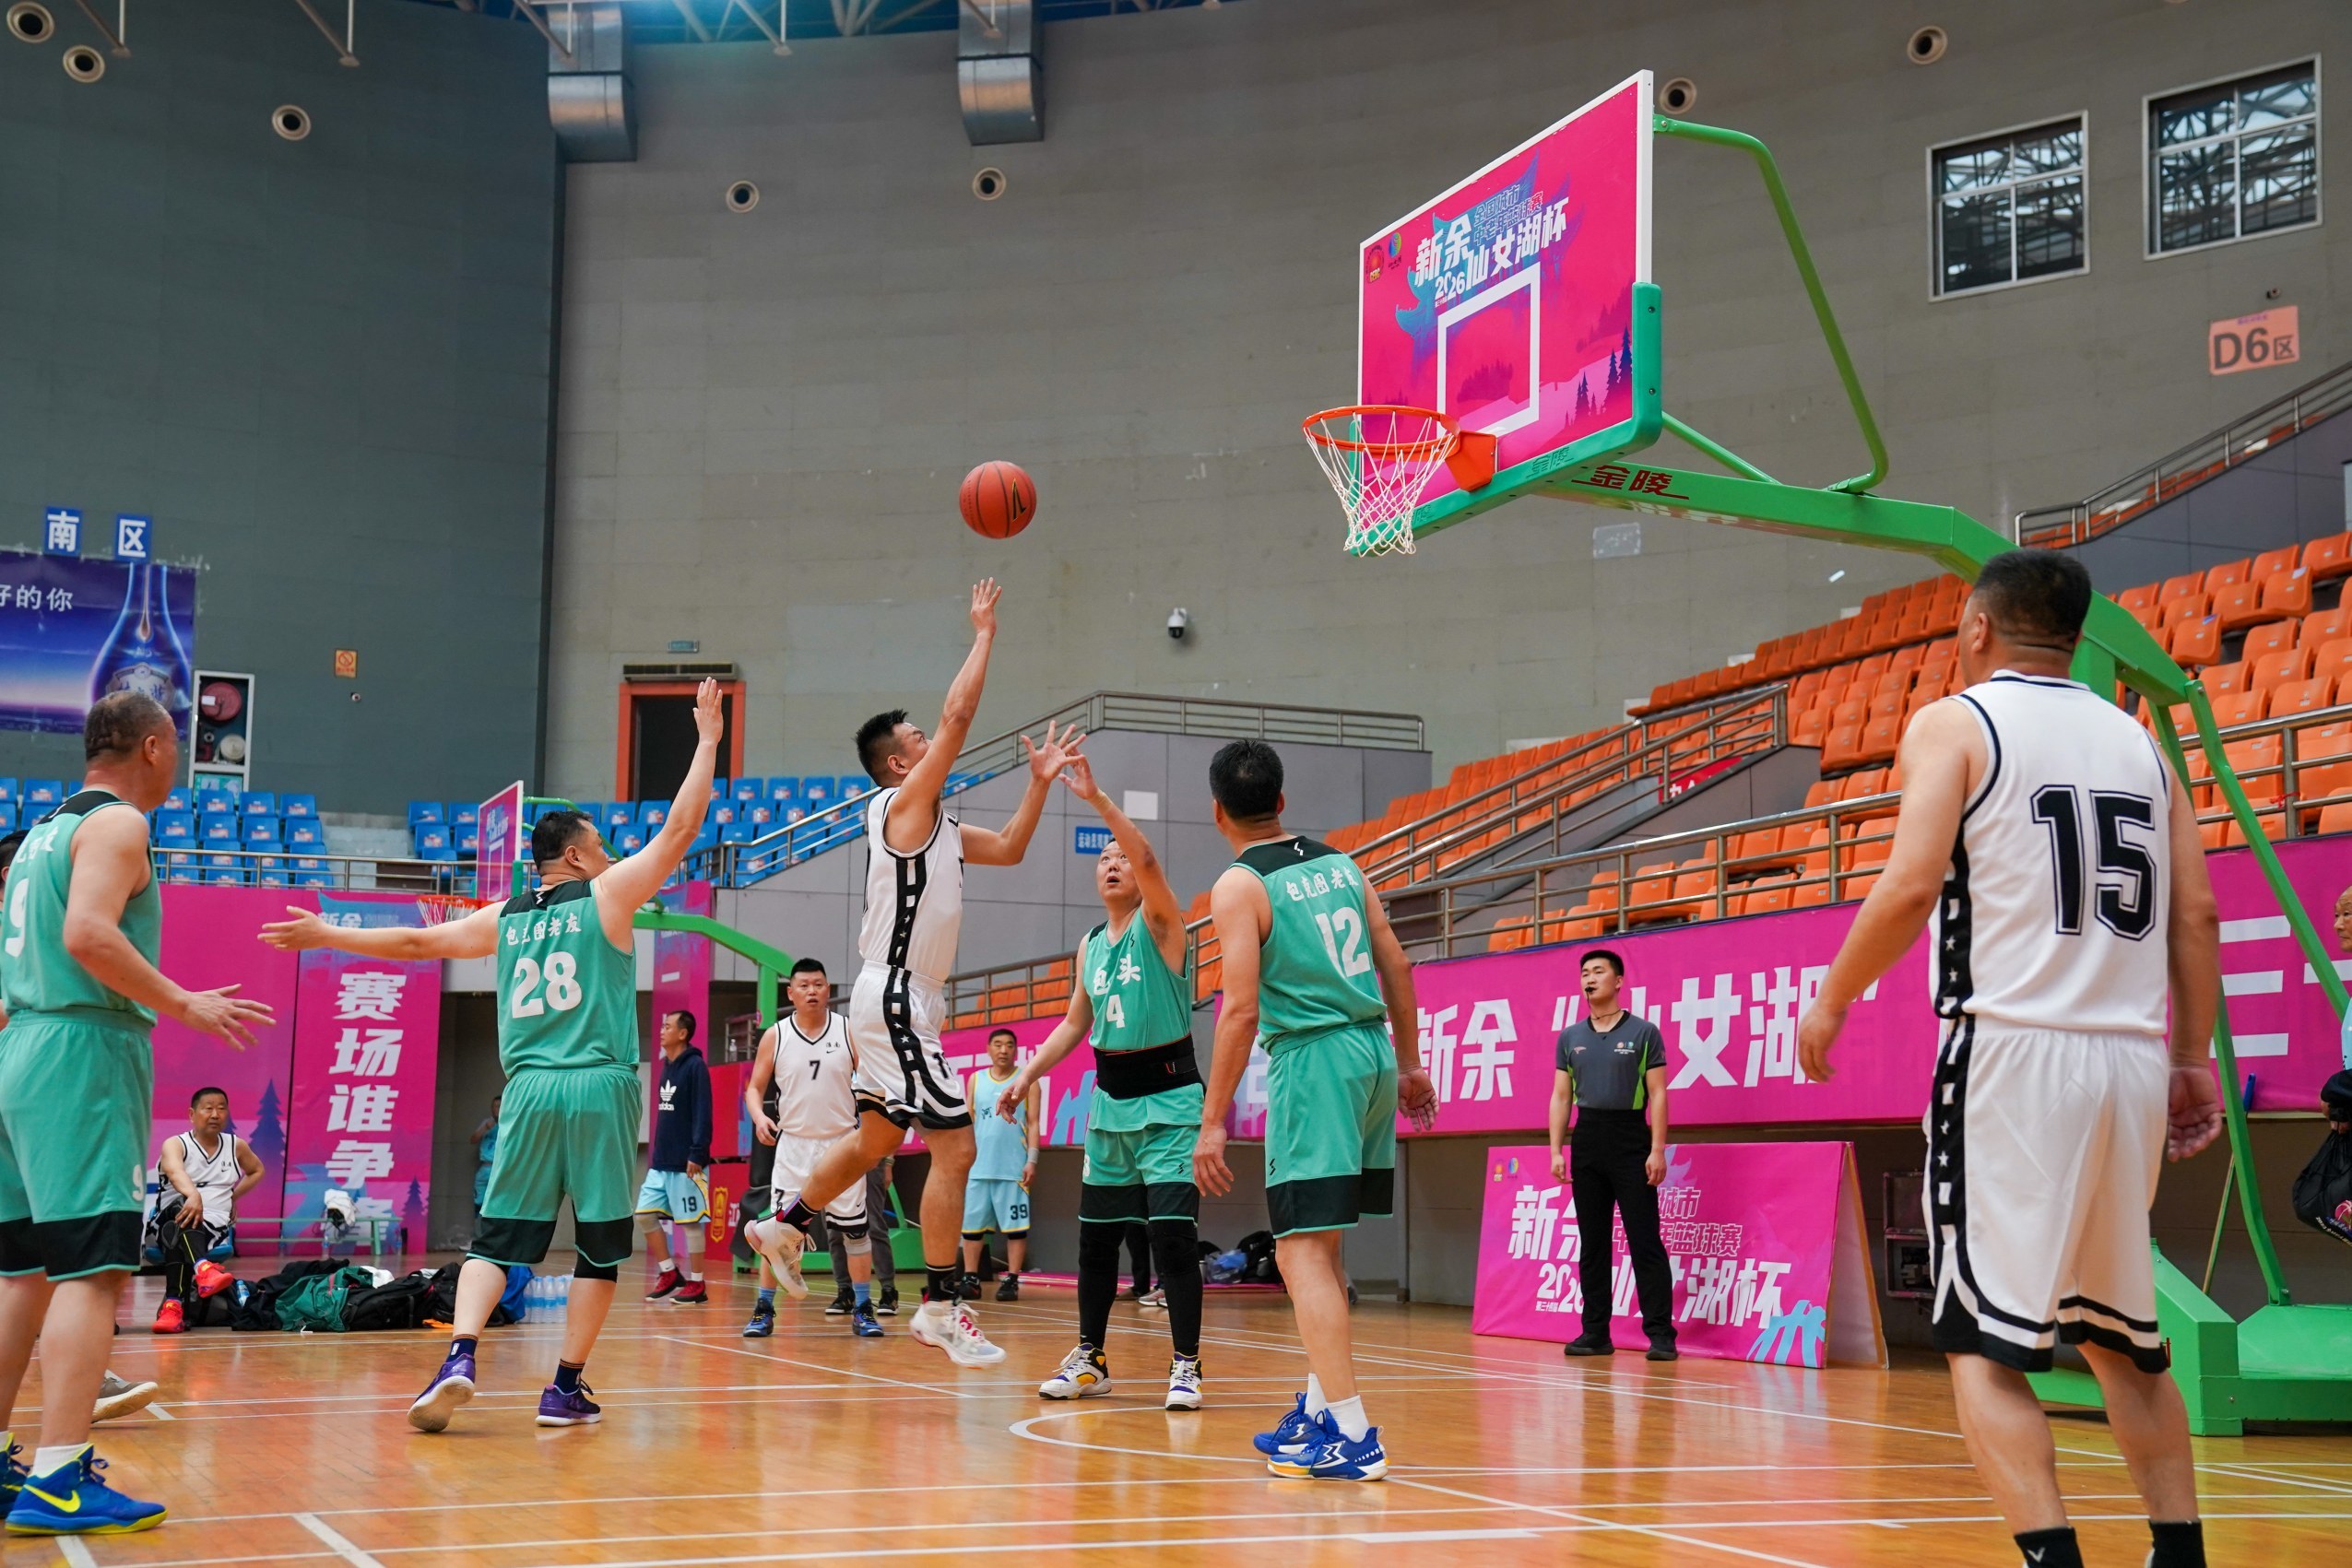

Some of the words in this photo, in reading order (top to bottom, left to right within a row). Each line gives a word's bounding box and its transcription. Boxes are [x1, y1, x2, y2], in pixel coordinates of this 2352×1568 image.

[1414, 213, 1472, 288] 新余
[1461, 196, 1569, 291] 仙女湖杯
[1435, 271, 1466, 301] 2026
[2214, 327, 2295, 369] D6区
[1588, 464, 1674, 495] 金陵
[2030, 784, 2157, 941] 15
[1315, 906, 1371, 978] 12
[512, 951, 582, 1018] 28
[1093, 953, 1141, 996] 包头
[1106, 994, 1126, 1029] 4
[810, 1060, 821, 1080] 7
[132, 1164, 144, 1201] 9
[682, 1196, 698, 1213] 19
[1010, 1203, 1029, 1220] 39
[1612, 1220, 1743, 1257] 中年篮球赛
